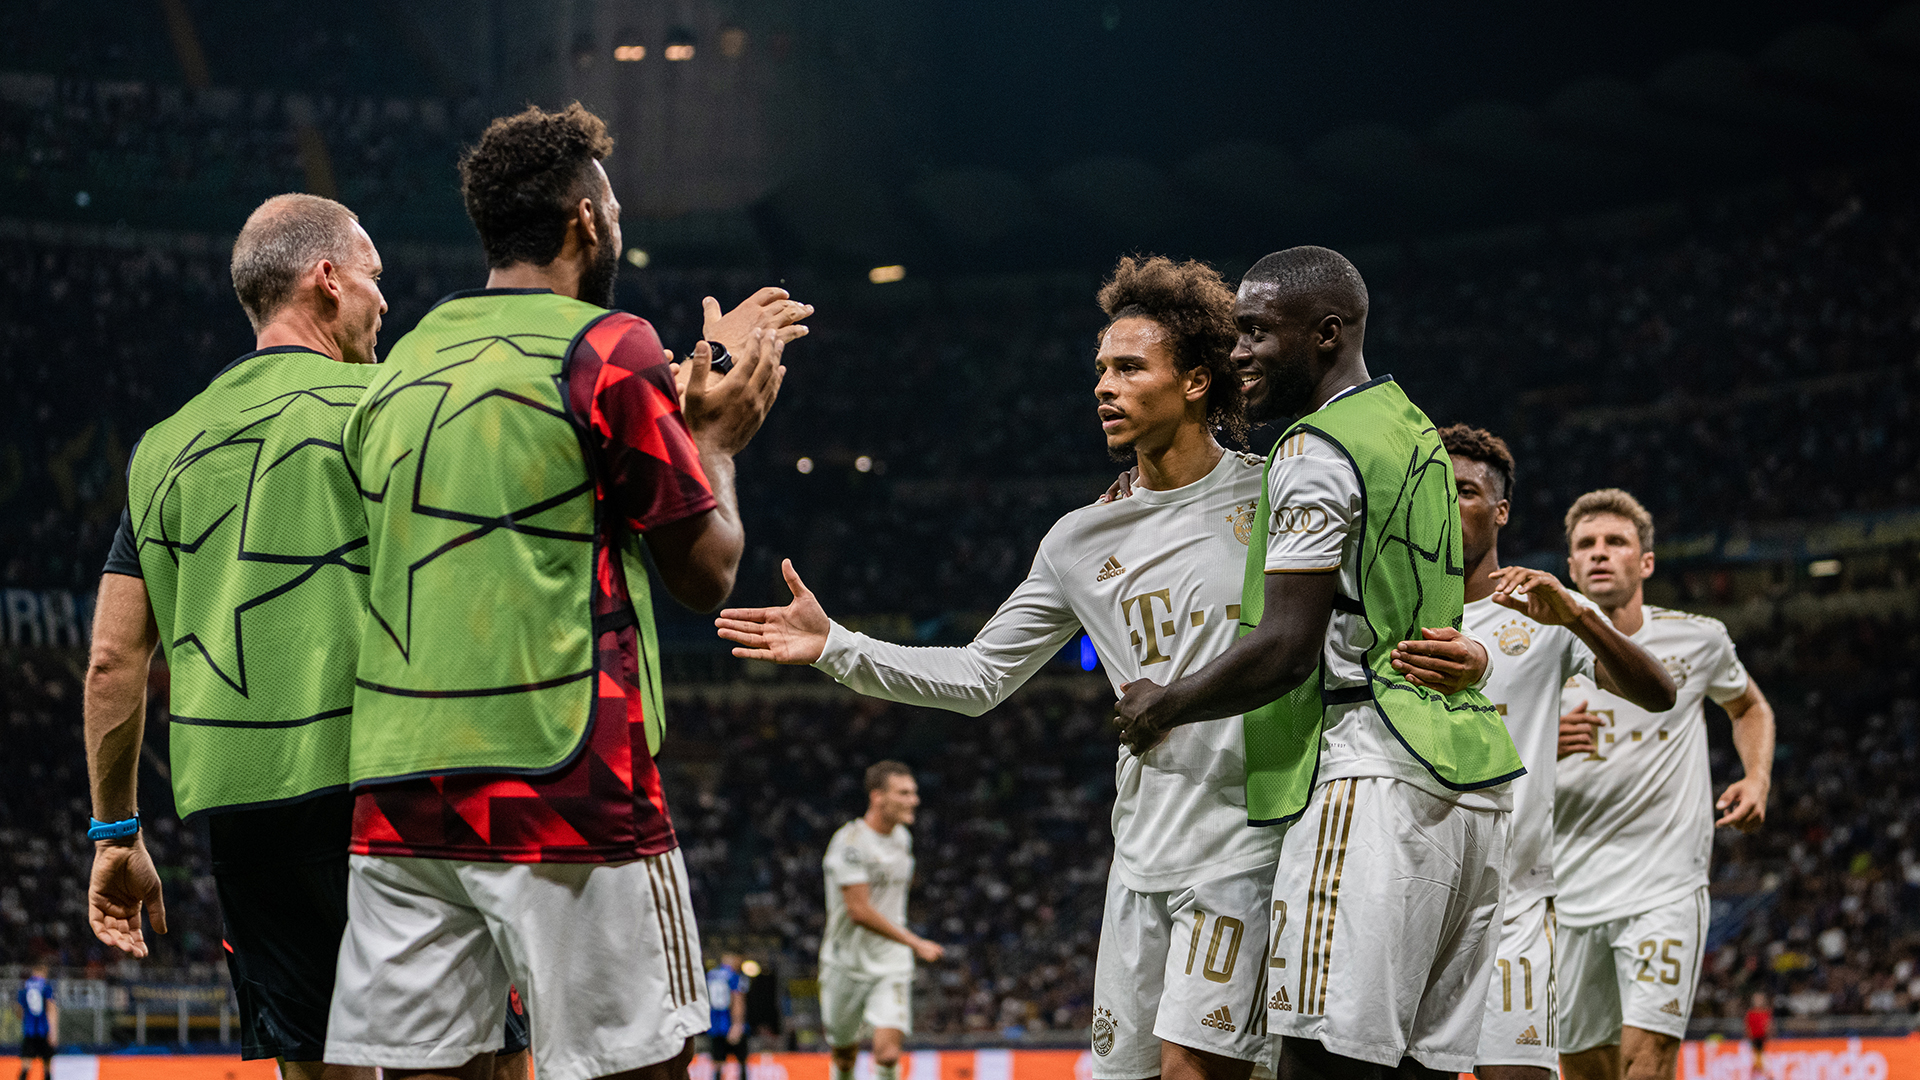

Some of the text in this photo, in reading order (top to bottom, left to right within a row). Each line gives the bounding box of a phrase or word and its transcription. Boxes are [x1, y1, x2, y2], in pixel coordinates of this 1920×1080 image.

[1096, 567, 1126, 582] adidas
[1185, 909, 1244, 984] 10
[1269, 900, 1287, 969] 2
[1637, 939, 1682, 986] 25
[1498, 957, 1532, 1012] 11
[1268, 1001, 1292, 1012] adidas
[1201, 1018, 1236, 1033] adidas
[1515, 1037, 1542, 1046] adidas
